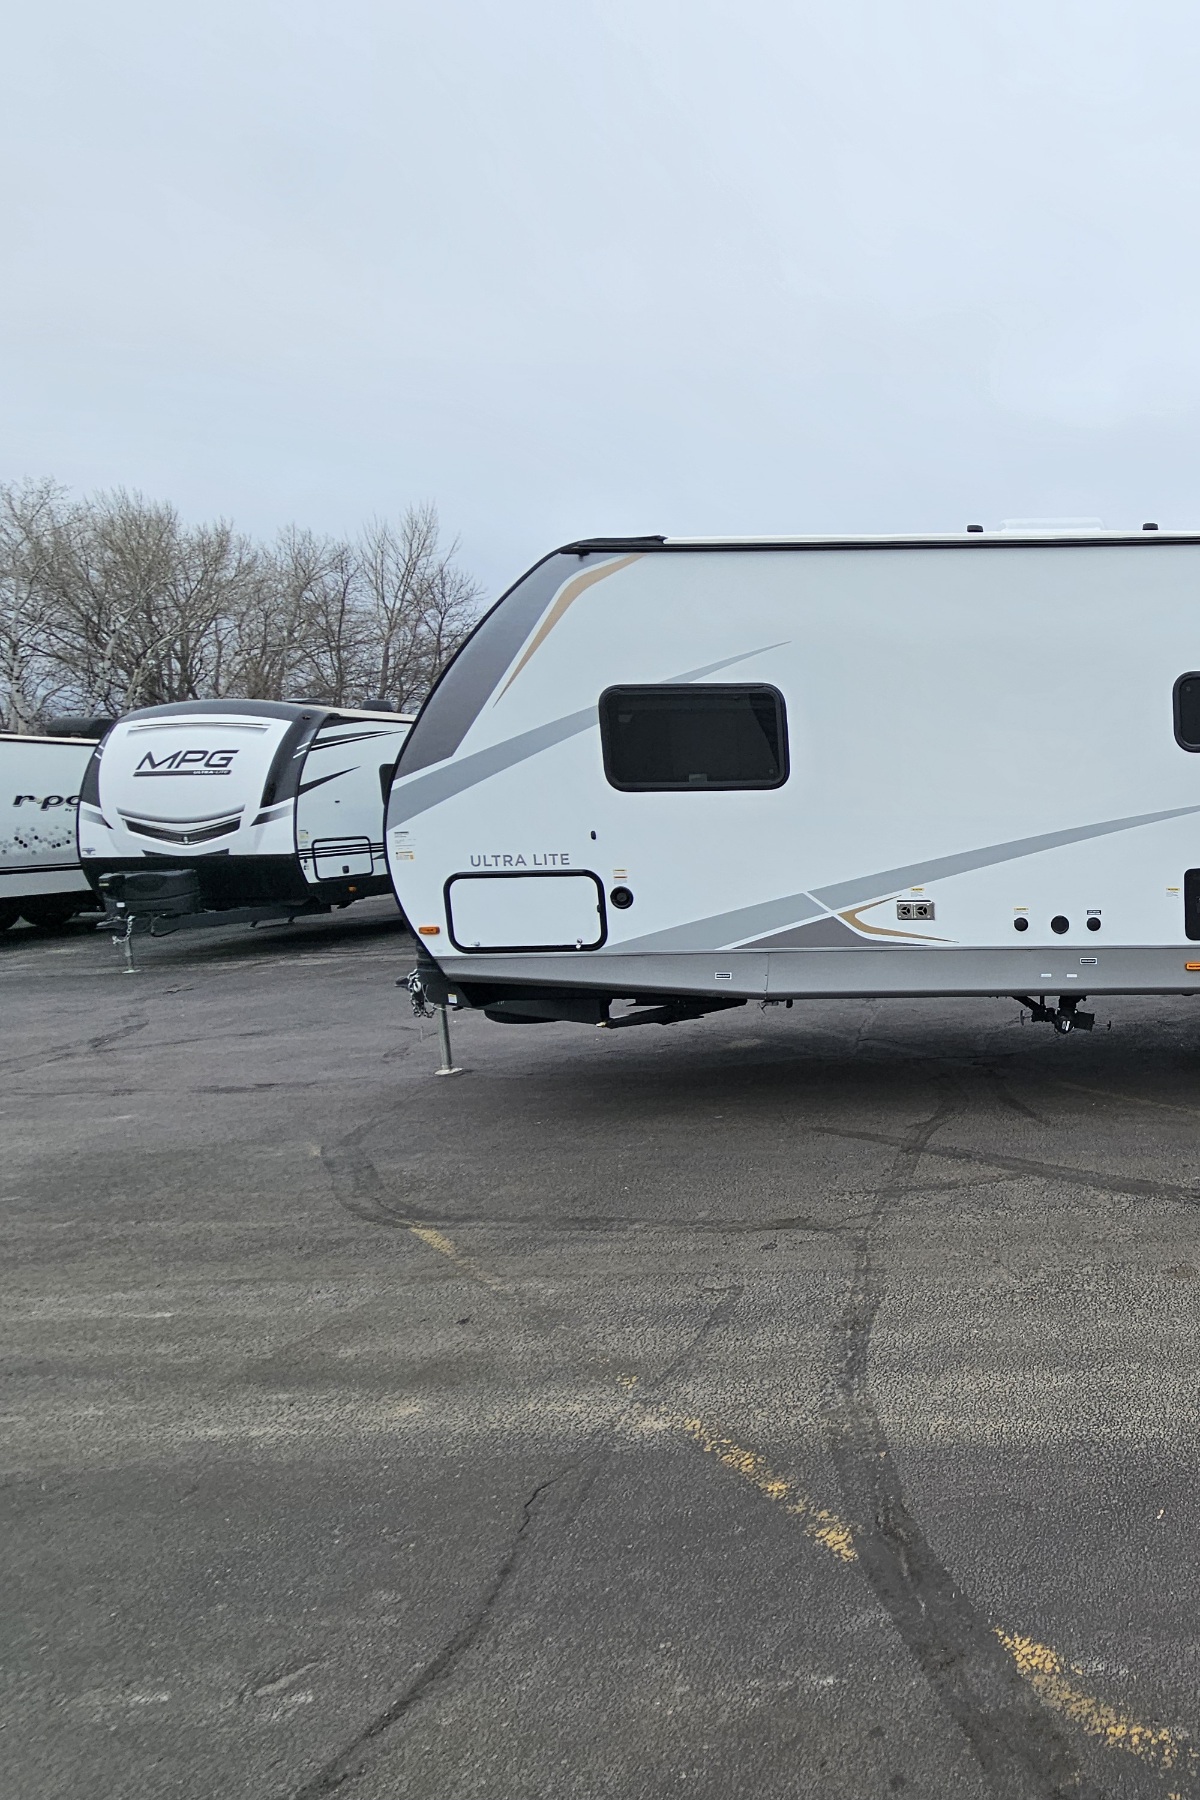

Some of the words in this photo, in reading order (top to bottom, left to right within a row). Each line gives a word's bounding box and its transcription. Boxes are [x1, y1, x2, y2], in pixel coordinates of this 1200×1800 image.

[135, 749, 240, 770] MPG
[470, 854, 527, 867] ULTRA
[533, 853, 570, 866] LITE
